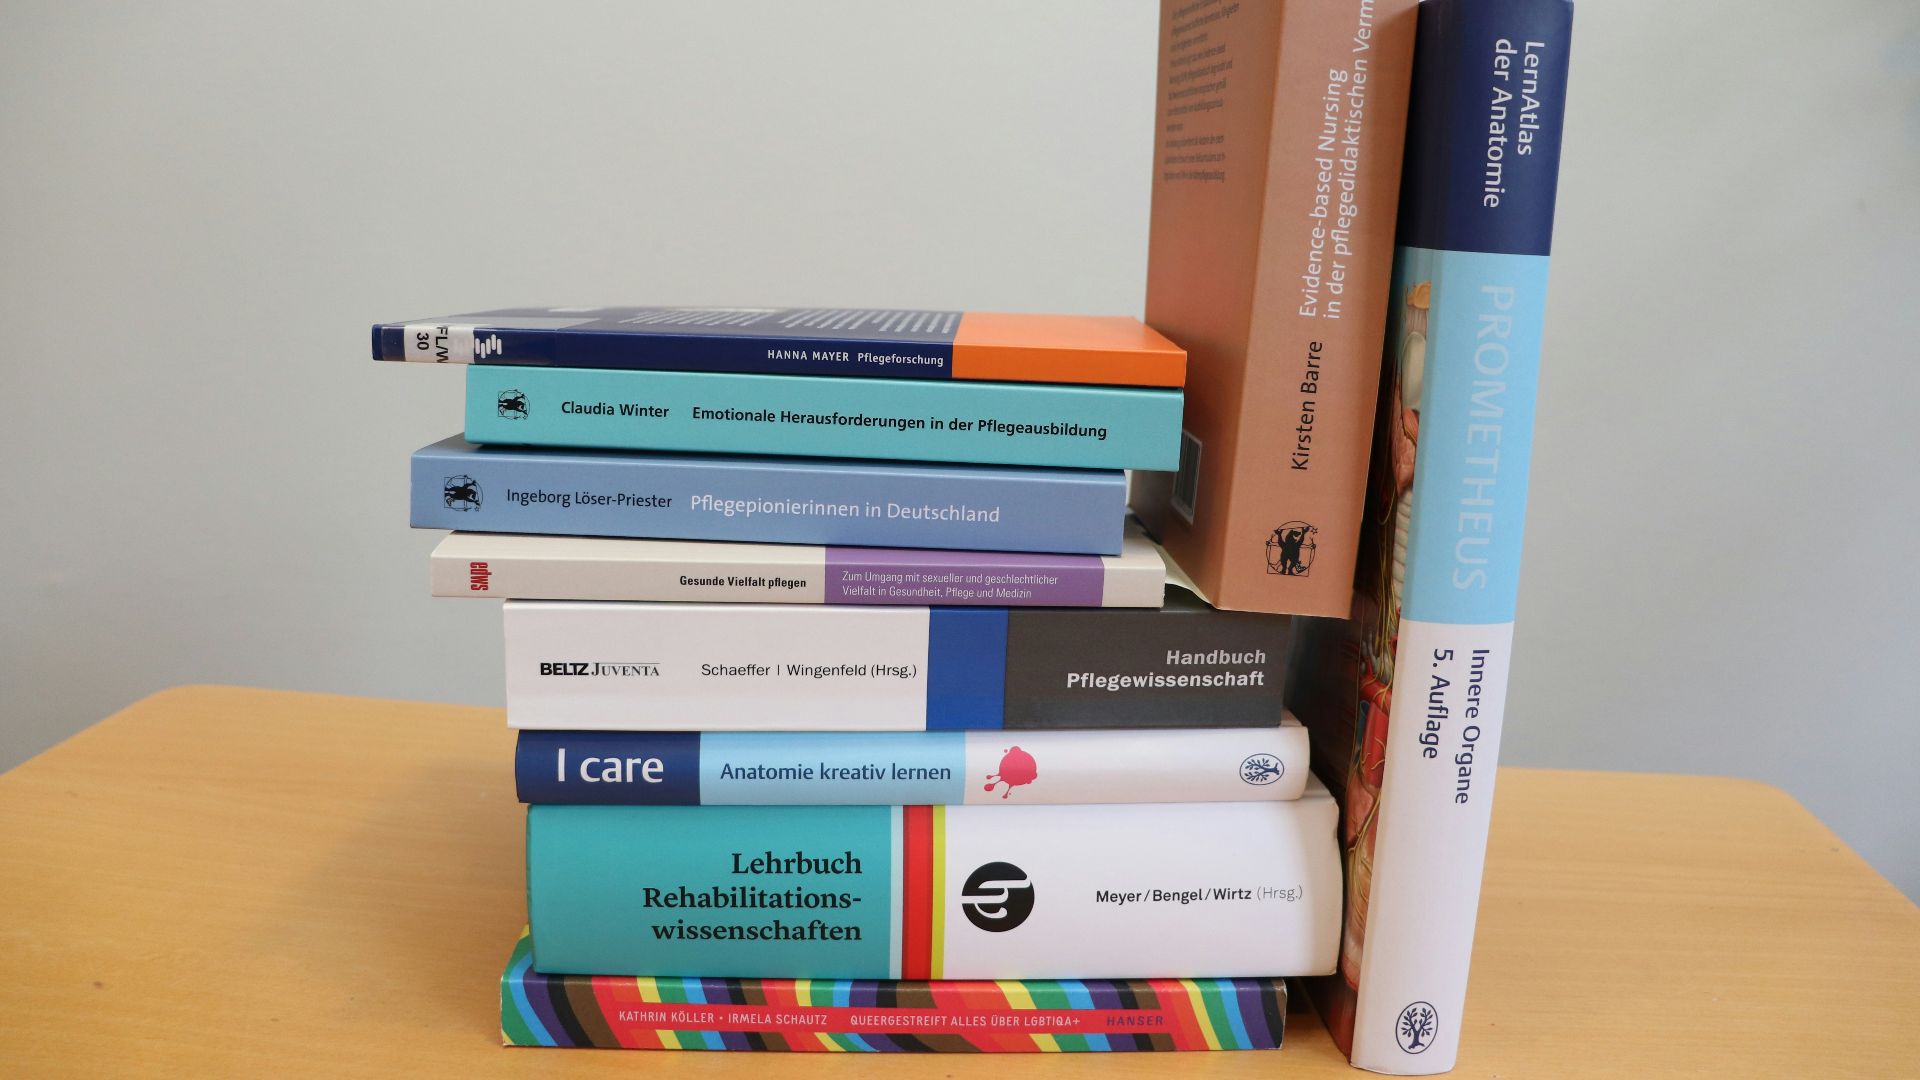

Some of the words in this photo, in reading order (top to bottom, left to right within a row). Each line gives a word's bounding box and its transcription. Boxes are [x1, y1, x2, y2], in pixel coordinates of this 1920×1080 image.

[1494, 38, 1518, 80] der
[1518, 41, 1545, 156] LernAtlas
[1331, 59, 1368, 256] pflegedidaktischen
[1484, 86, 1512, 208] Anatomie
[1300, 157, 1333, 316] Evidence-based
[1318, 69, 1348, 151] Nursing
[1326, 261, 1346, 294] der
[1323, 301, 1342, 319] in
[416, 332, 430, 350] 30
[767, 349, 808, 361] HANNA
[812, 351, 850, 363] MAYER
[858, 352, 944, 368] Pflegeforschung
[1301, 341, 1322, 394] Barre
[561, 401, 614, 417] Claudia
[620, 404, 670, 418] Winter
[692, 406, 776, 423] Emotionale
[780, 410, 925, 432] Herausforderungen
[930, 416, 945, 430] in
[948, 417, 974, 432] der
[978, 419, 1107, 441] Pflegeausbildung
[1291, 400, 1316, 470] Kirsten
[1452, 285, 1515, 590] PROMETHEUS
[506, 488, 571, 508] Ingeborg
[575, 491, 672, 508] Löser-Priester
[690, 495, 860, 519] Pflegepionierinnen
[865, 503, 882, 518] in
[888, 504, 1000, 522] Deutschland
[470, 562, 492, 590] edws
[679, 575, 725, 587] Gesunde
[727, 576, 766, 588] Vielfalt
[768, 576, 806, 590] pflegen
[842, 571, 862, 583] Zum
[864, 571, 902, 586] Umgang
[905, 572, 920, 584] mit
[922, 572, 964, 585] sexueller
[966, 573, 982, 586] und
[984, 574, 1058, 589] geschlechtlicher
[842, 586, 876, 598] Vielfalt
[878, 586, 886, 598] in
[888, 586, 943, 600] Gesundheit,
[946, 587, 974, 601] Pflege
[976, 588, 994, 599] und
[996, 588, 1032, 600] Medizin
[540, 662, 589, 676] BELTZ
[1166, 650, 1266, 666] Handbuch
[1432, 648, 1454, 668] 5.
[701, 664, 770, 676] Schaeffer
[786, 664, 867, 679] Wingenfeld
[870, 664, 917, 679] (Hrsg.)
[1066, 672, 1265, 691] Pflegewissenschaft
[1466, 650, 1490, 718] Innere
[1419, 674, 1450, 758] Auflage
[558, 748, 565, 782] I
[580, 756, 664, 784] care
[720, 762, 814, 781] Anatomie
[820, 762, 886, 780] kreativ
[892, 762, 951, 780] lernen
[1455, 726, 1480, 804] Organe
[732, 851, 862, 874] Lehrbuch
[642, 886, 862, 909] Rehabilitations-
[1256, 886, 1303, 902] (Hrsg.)
[652, 920, 862, 941] wissenschaften
[619, 1010, 666, 1023] KATHRIN
[671, 1010, 714, 1024] KÖLLER
[728, 1014, 771, 1025] IRMELA
[776, 1014, 828, 1026] SCHAUTZ
[850, 1015, 948, 1027] QUEERGESTREIFT
[950, 1016, 986, 1027] ALLES
[990, 1014, 1020, 1027] ÜBER
[1024, 1016, 1080, 1028] LGBTIQA+
[1106, 1015, 1164, 1026] HANSER
